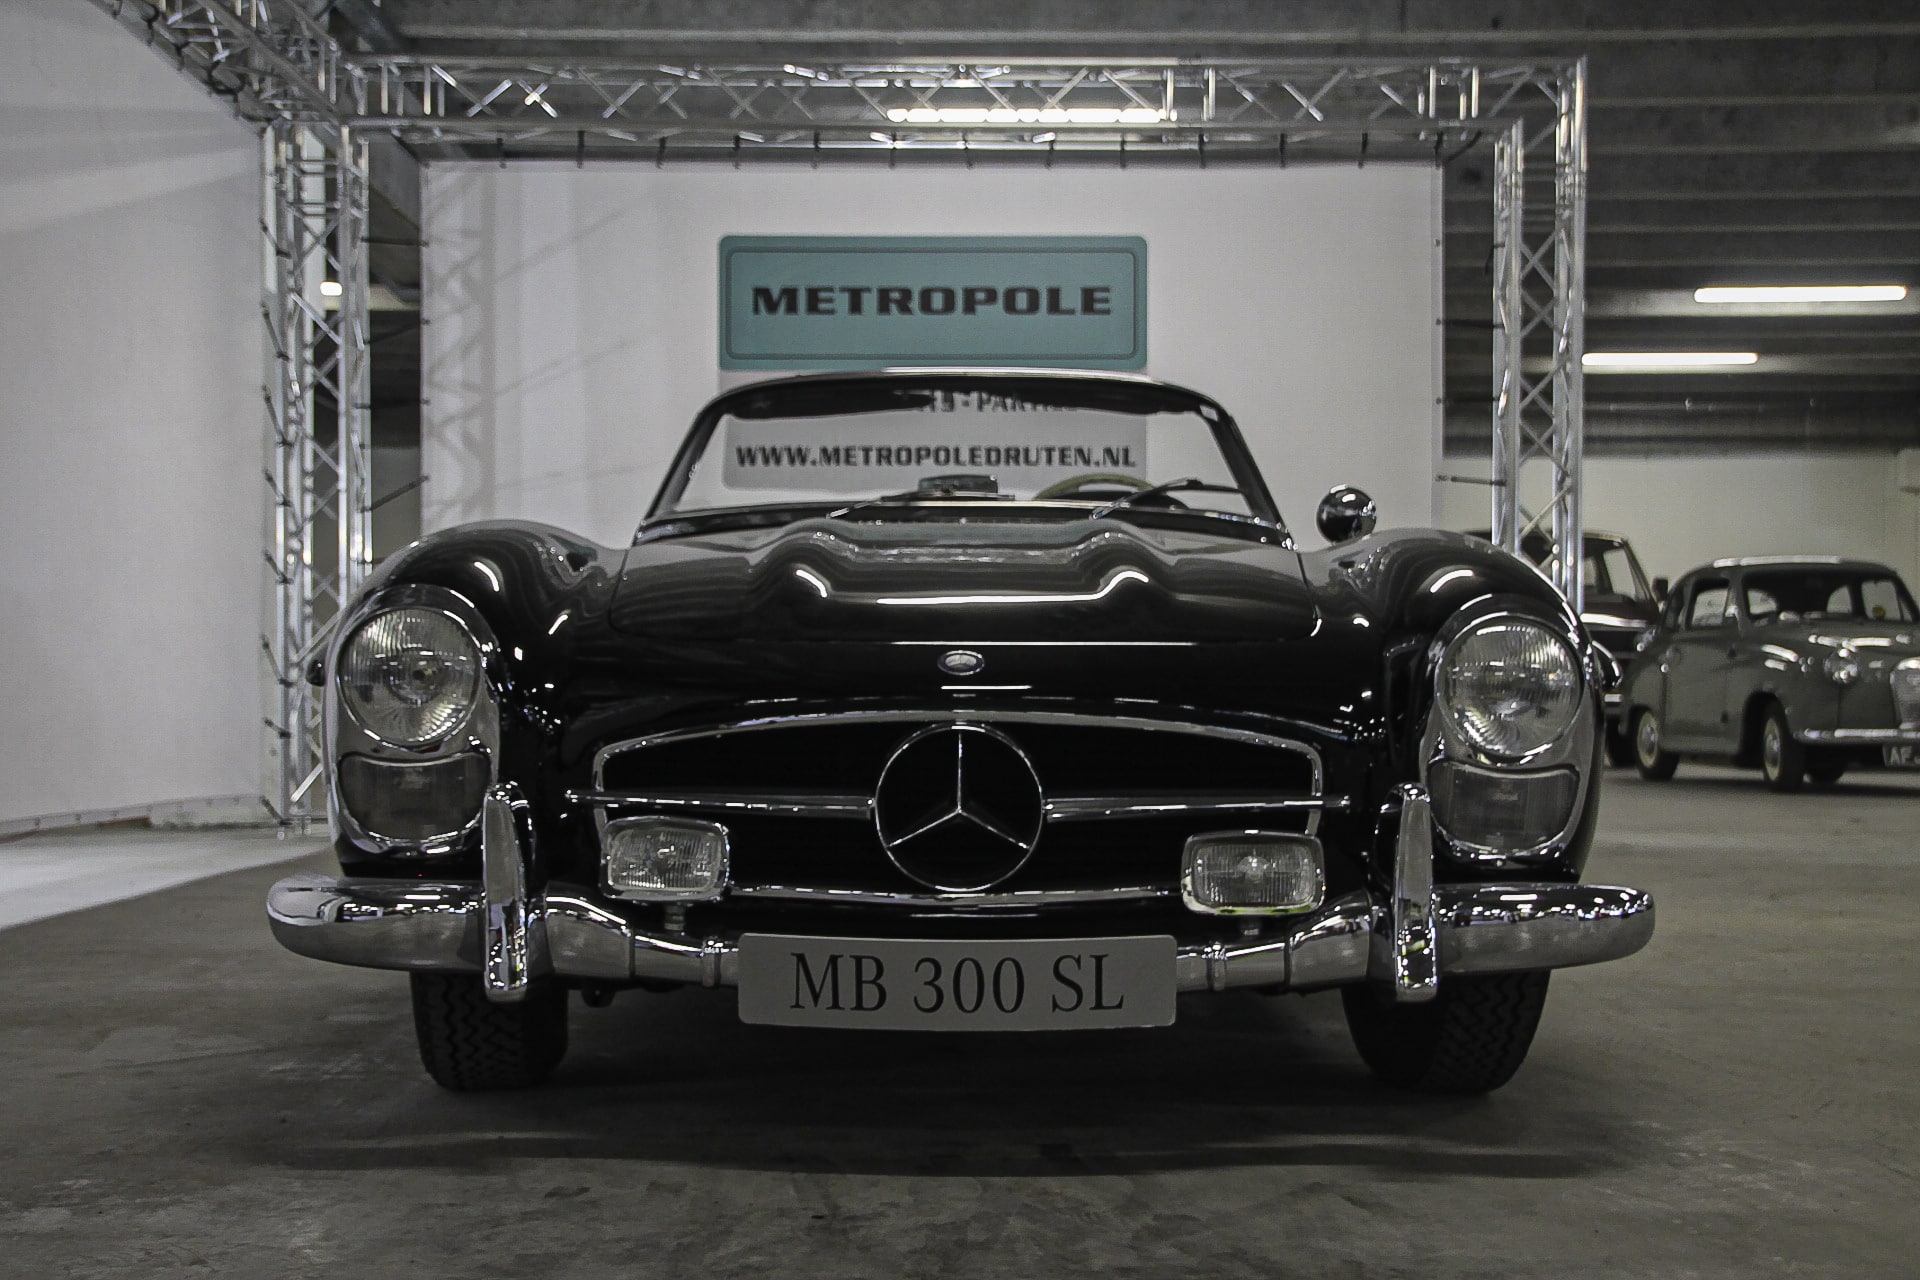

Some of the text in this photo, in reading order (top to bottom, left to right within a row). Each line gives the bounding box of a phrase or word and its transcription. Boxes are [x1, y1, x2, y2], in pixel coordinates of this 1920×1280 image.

[752, 286, 1112, 316] METROPOLE
[735, 445, 1137, 468] WWW.METROPOLEDRUTEN.NL
[790, 952, 1125, 1014] MB 300 SL
